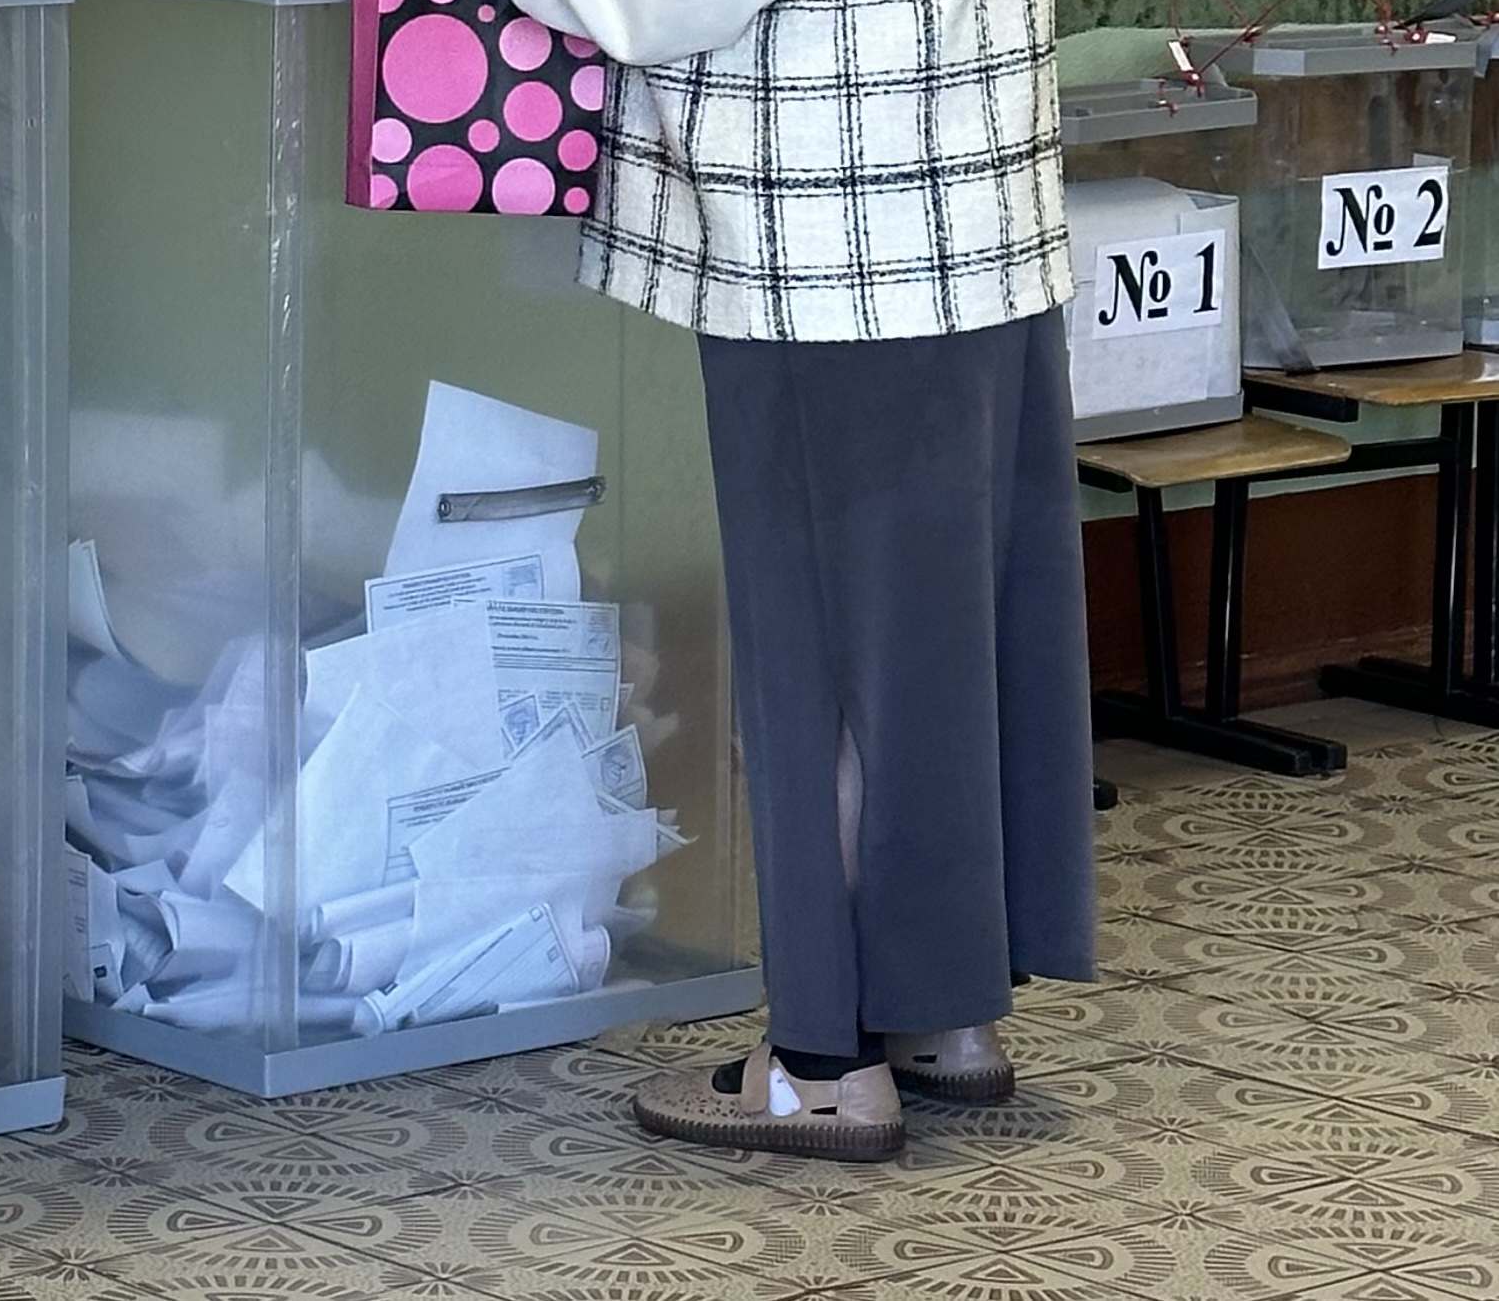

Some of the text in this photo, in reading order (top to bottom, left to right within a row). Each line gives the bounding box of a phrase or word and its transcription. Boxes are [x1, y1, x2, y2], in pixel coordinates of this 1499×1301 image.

[1326, 178, 1444, 256] № 2
[1098, 242, 1219, 325] № 1
